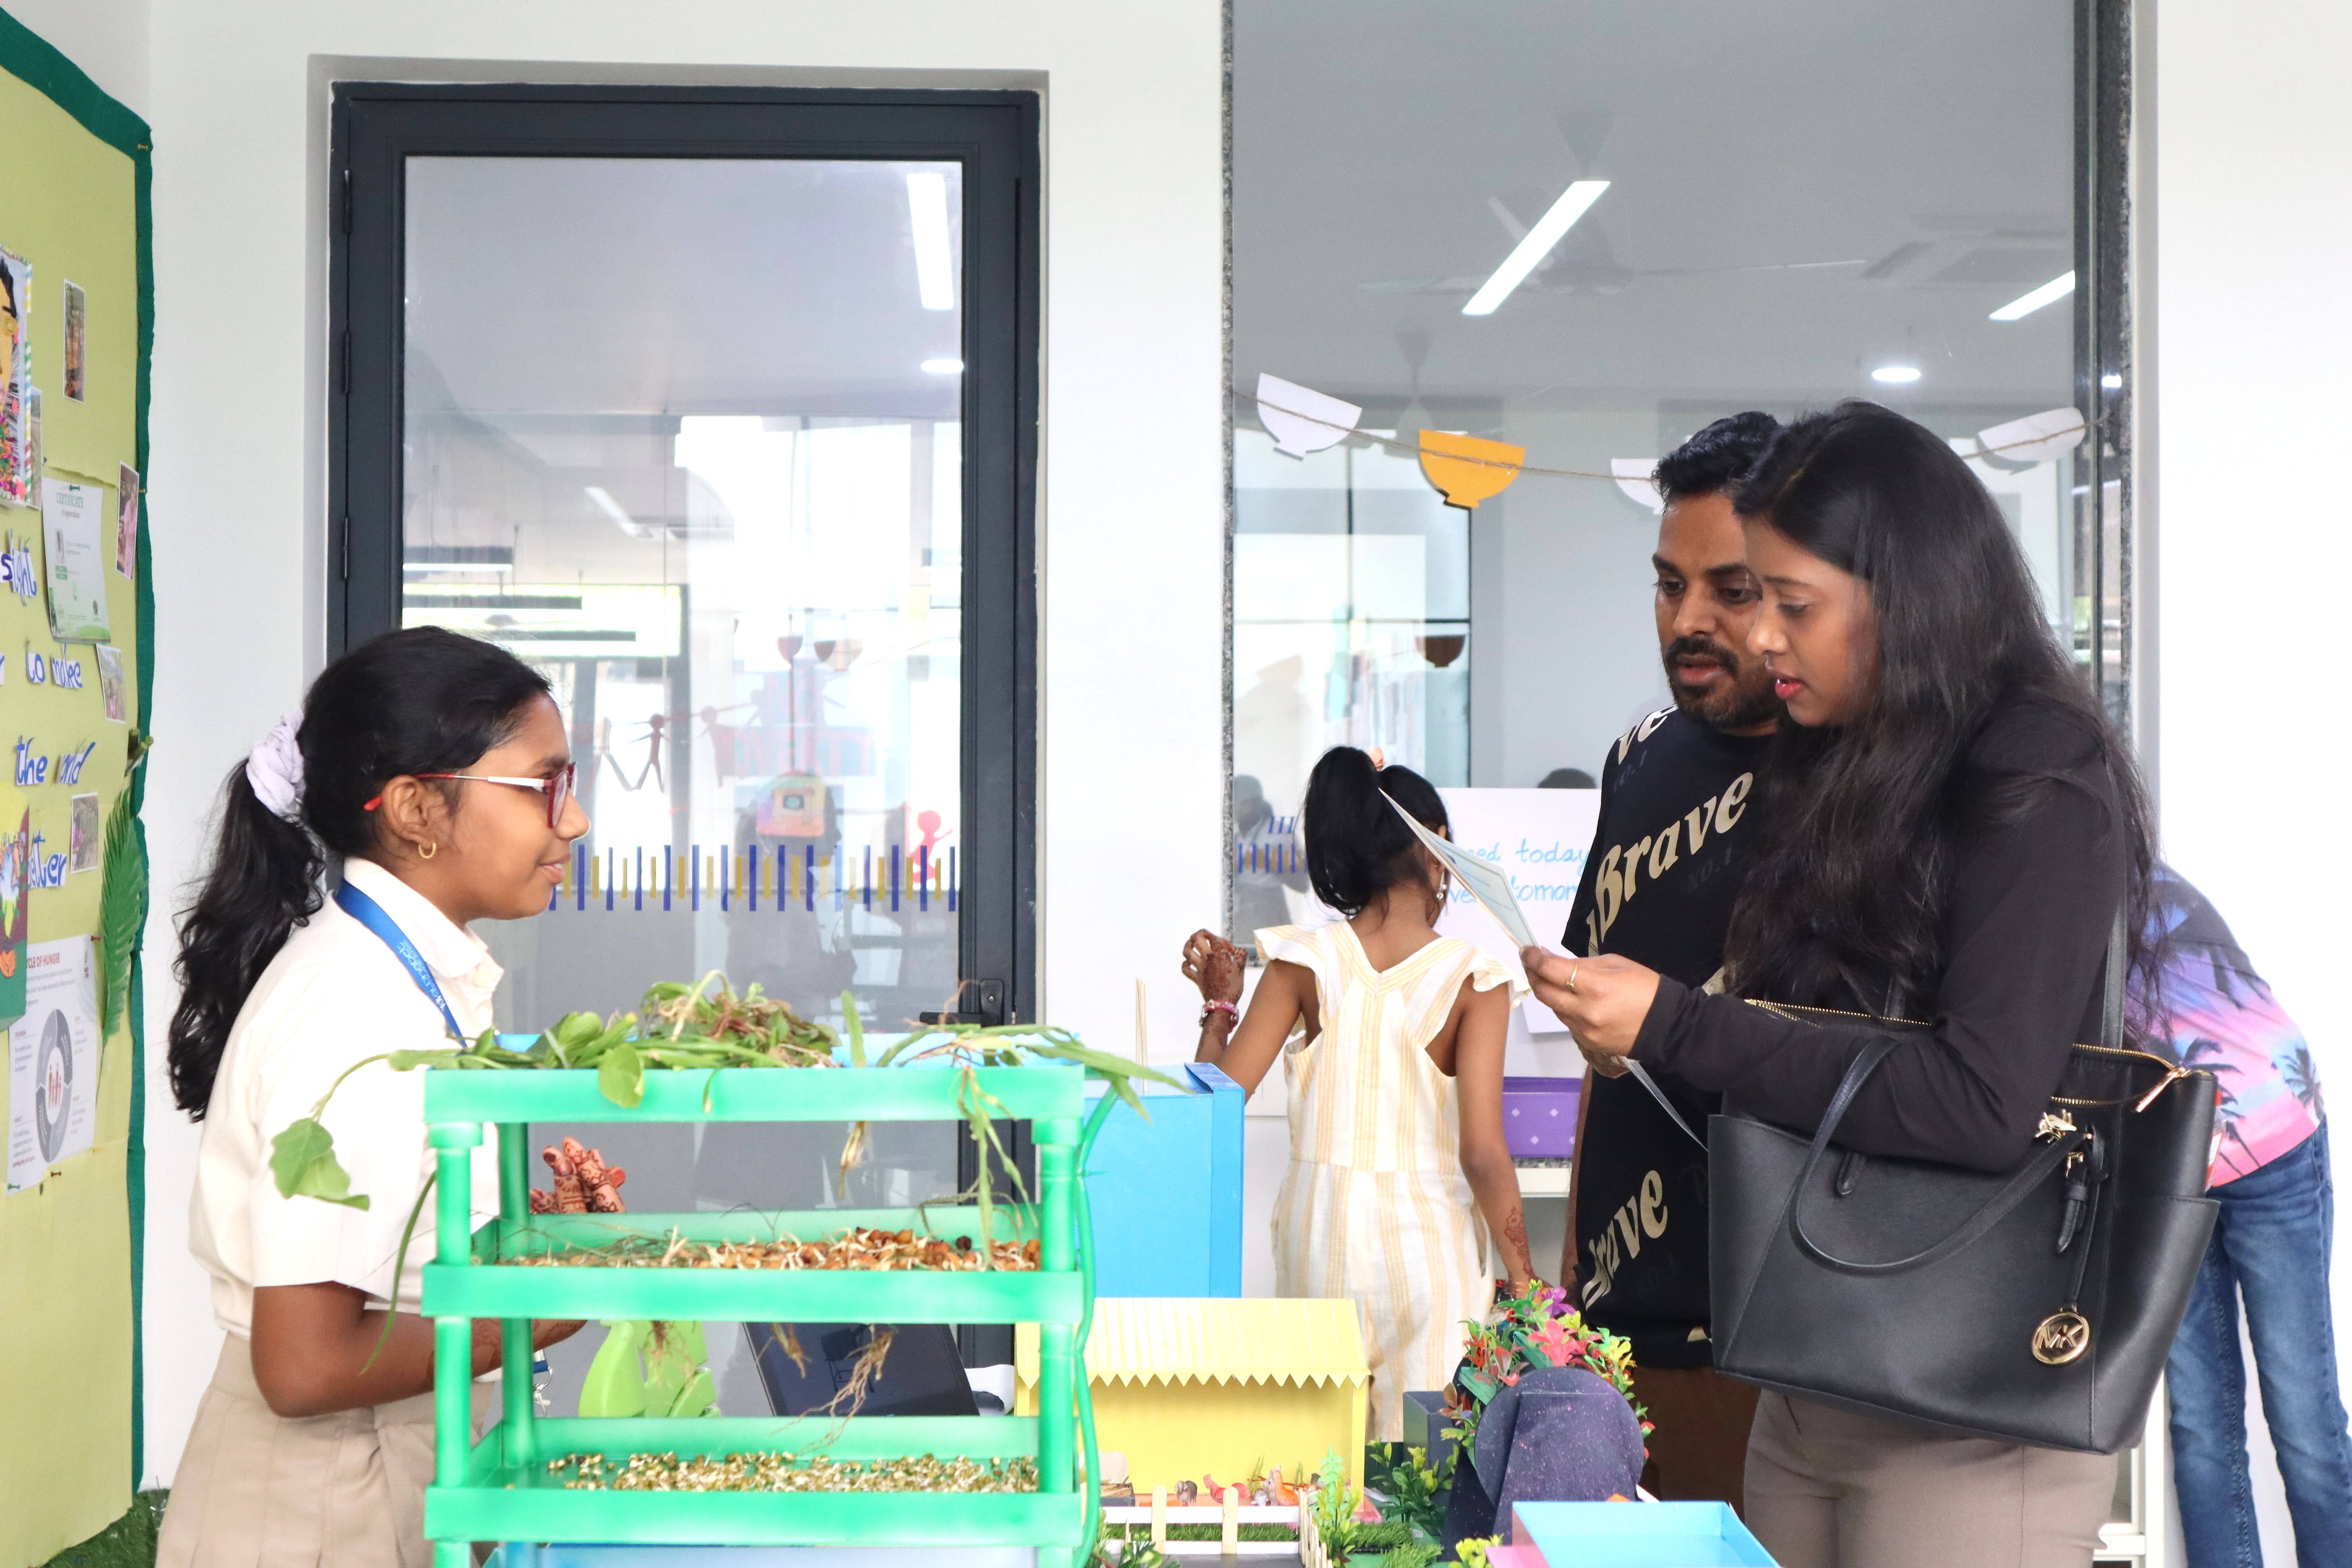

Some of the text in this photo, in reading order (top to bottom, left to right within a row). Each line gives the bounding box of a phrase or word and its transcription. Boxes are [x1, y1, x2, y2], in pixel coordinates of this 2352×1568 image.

[57, 492, 84, 508] CERTIFICATE
[26, 646, 45, 683] to
[52, 642, 83, 688] make
[1619, 703, 1679, 765] ve
[16, 735, 48, 784] the
[1515, 838, 1590, 877] today
[1595, 771, 1753, 943] Brave
[1510, 875, 1578, 901] tomor
[27, 953, 60, 969] CLE OF HUNGER
[2036, 1325, 2083, 1349] MK
